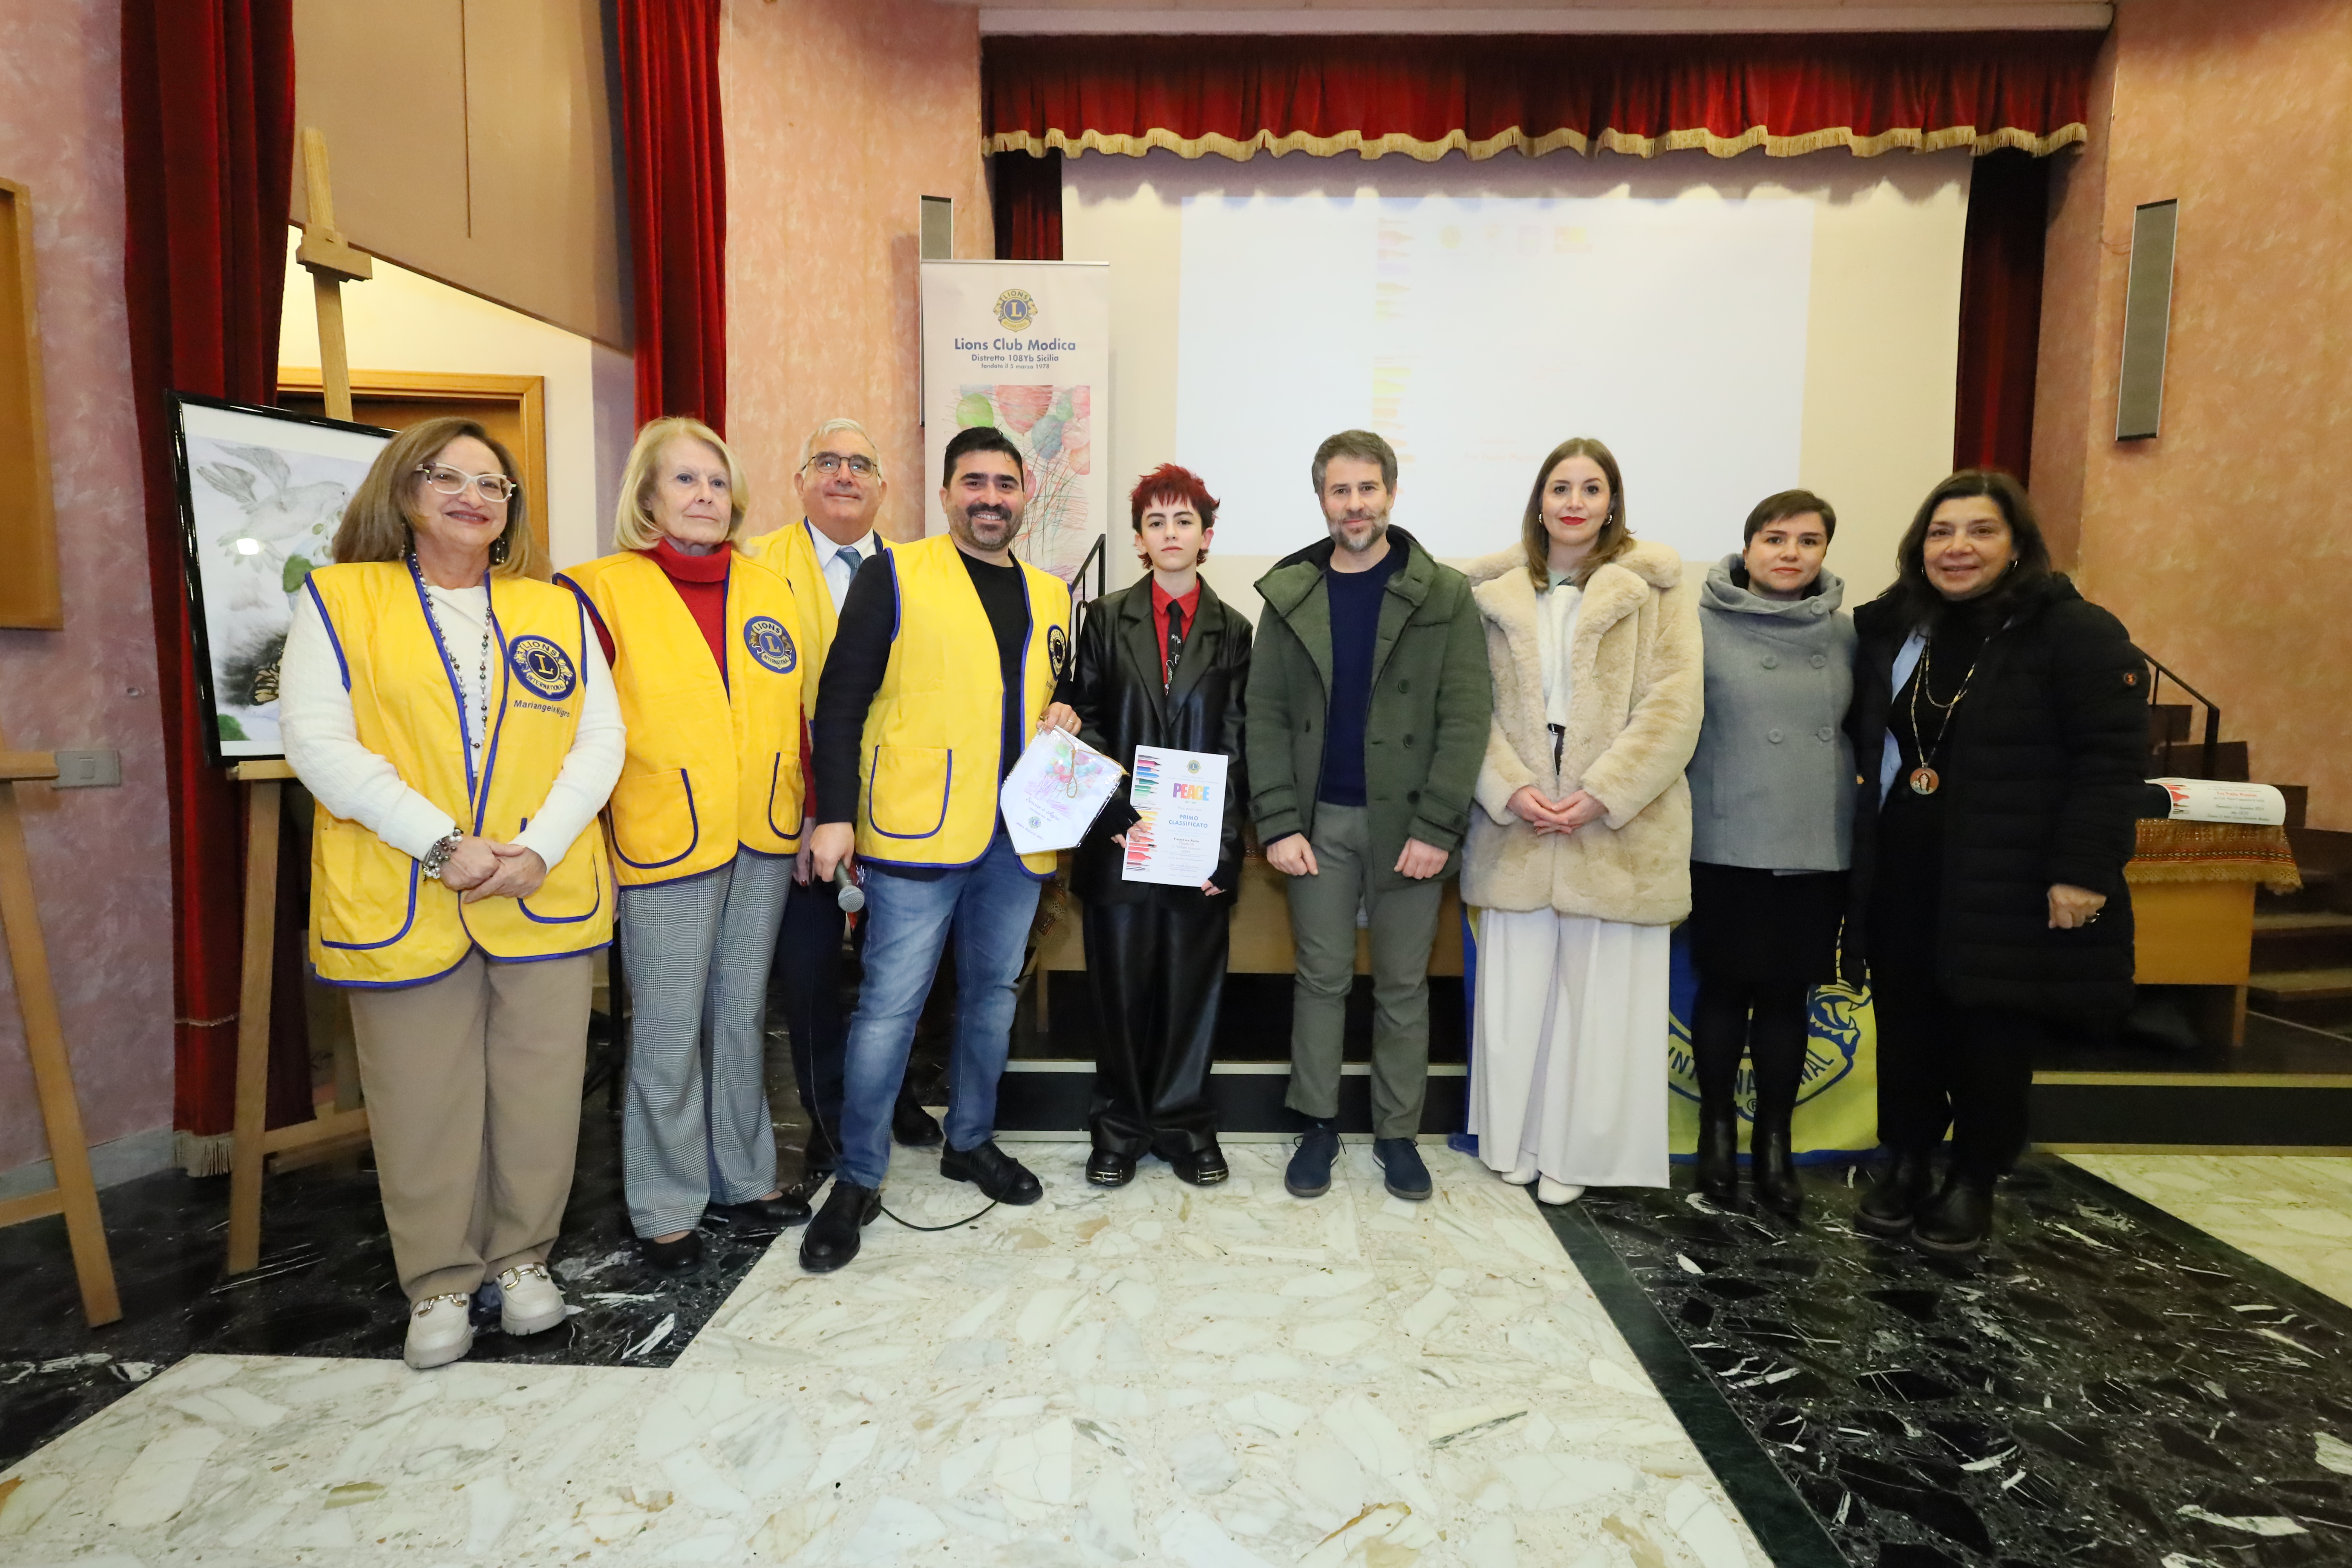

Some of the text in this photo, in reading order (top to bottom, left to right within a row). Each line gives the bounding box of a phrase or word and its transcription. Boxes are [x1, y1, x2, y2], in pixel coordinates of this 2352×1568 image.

[1003, 291, 1028, 300] LIONS
[1011, 302, 1022, 317] L
[955, 338, 1076, 351] Lions Club Modica
[753, 622, 780, 634] LIONS
[522, 641, 558, 657] LIONS
[765, 635, 781, 653] L
[534, 654, 554, 675] L
[763, 654, 790, 665] INTERNATIONAL
[527, 674, 566, 691] INTERNATIONAL
[1173, 783, 1210, 801] PEACE
[1168, 820, 1208, 828] CLASSIFICATO
